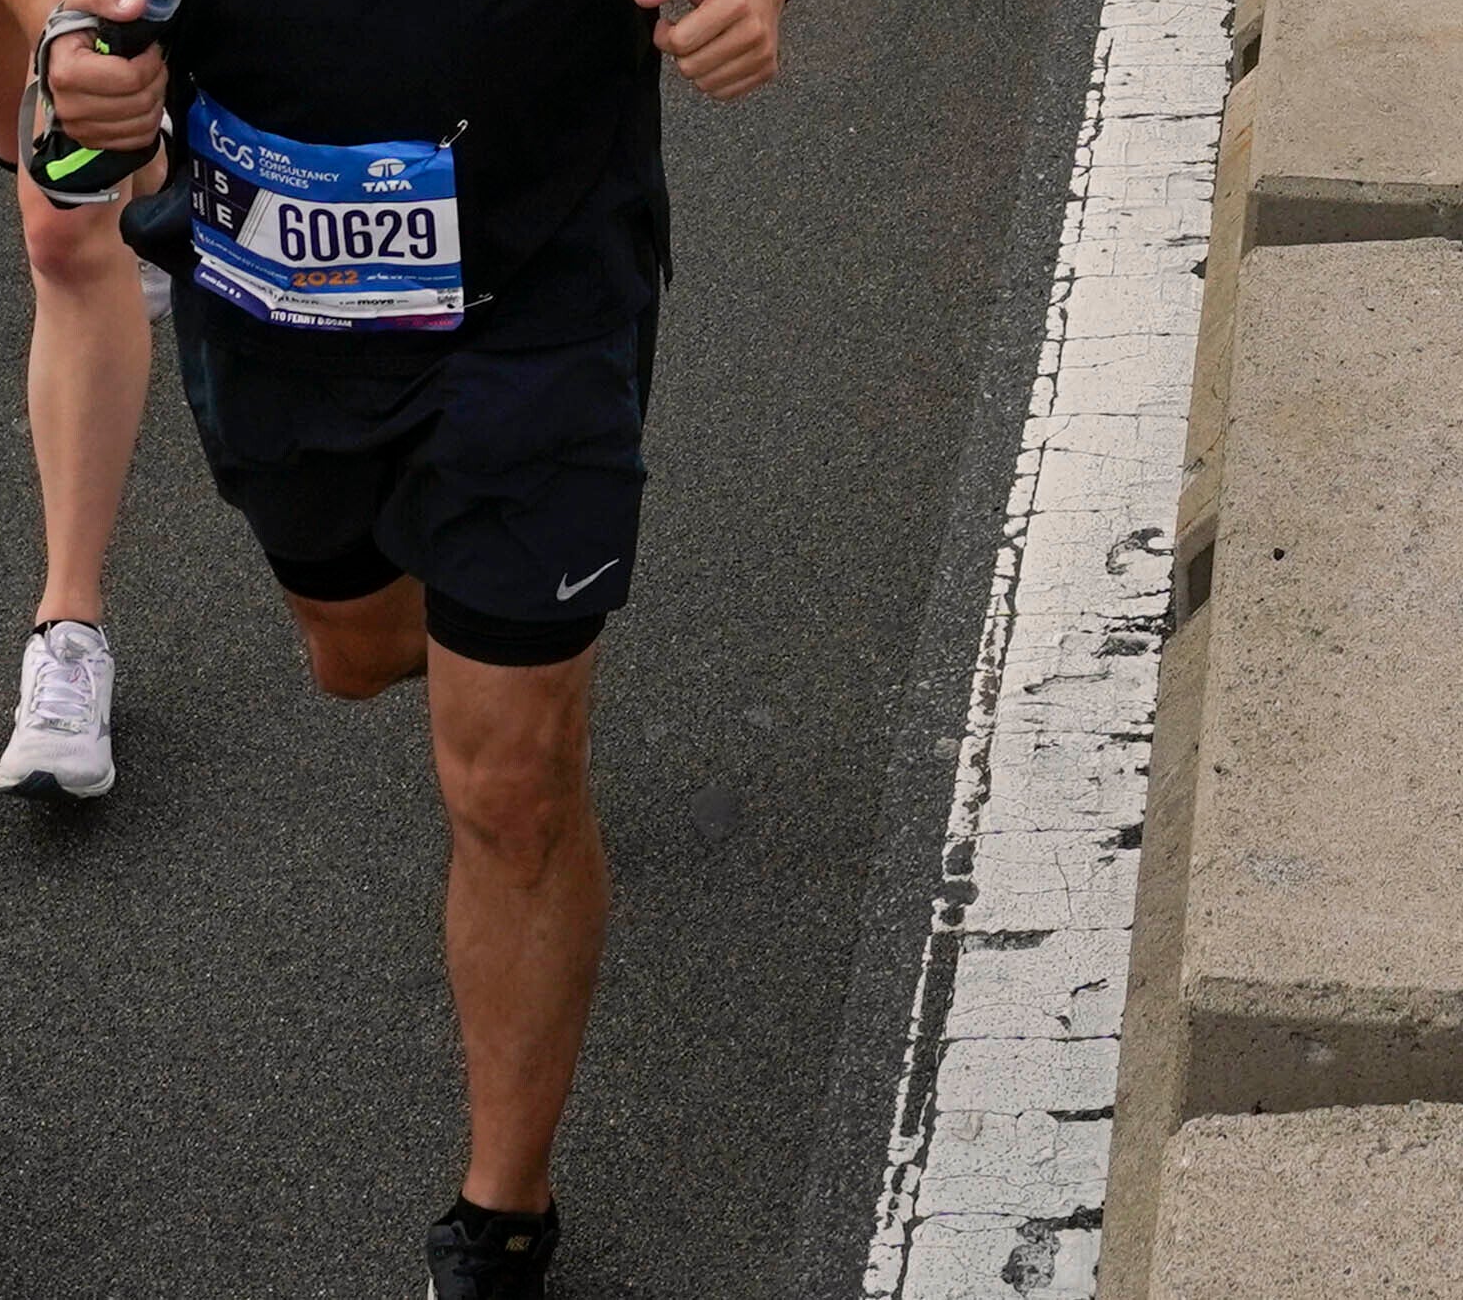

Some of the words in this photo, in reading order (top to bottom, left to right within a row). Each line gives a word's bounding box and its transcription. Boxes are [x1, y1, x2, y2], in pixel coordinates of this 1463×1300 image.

[207, 119, 254, 172] tcs
[257, 145, 291, 166] TATA
[213, 169, 229, 195] 5
[257, 156, 341, 182] CONSULTANCY
[257, 168, 311, 190] SERVICES
[362, 177, 415, 194] TATA
[216, 201, 234, 230] E
[277, 202, 439, 263] 60629
[292, 270, 359, 288] 2022
